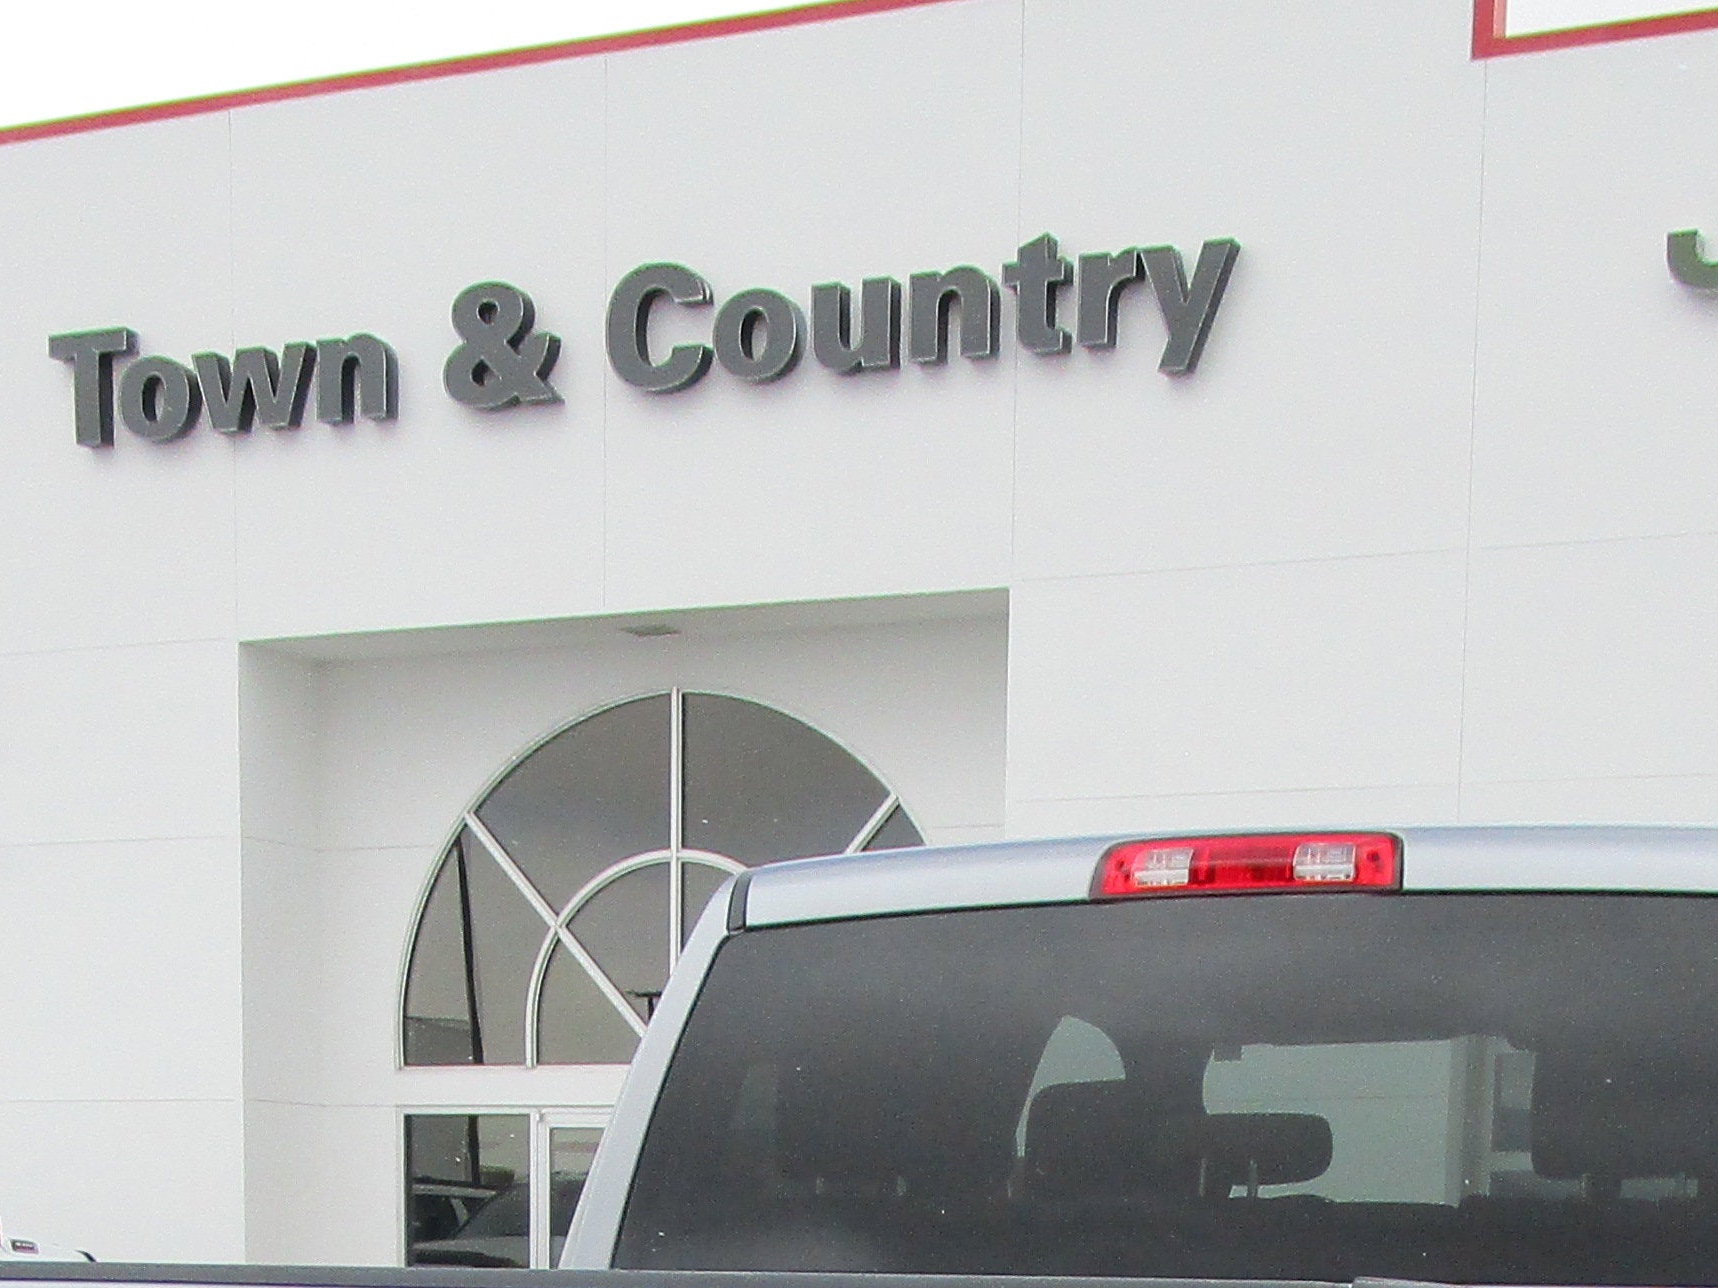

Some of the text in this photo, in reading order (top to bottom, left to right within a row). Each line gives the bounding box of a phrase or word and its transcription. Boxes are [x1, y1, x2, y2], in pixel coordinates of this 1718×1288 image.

[48, 234, 1241, 448] Town & Country
